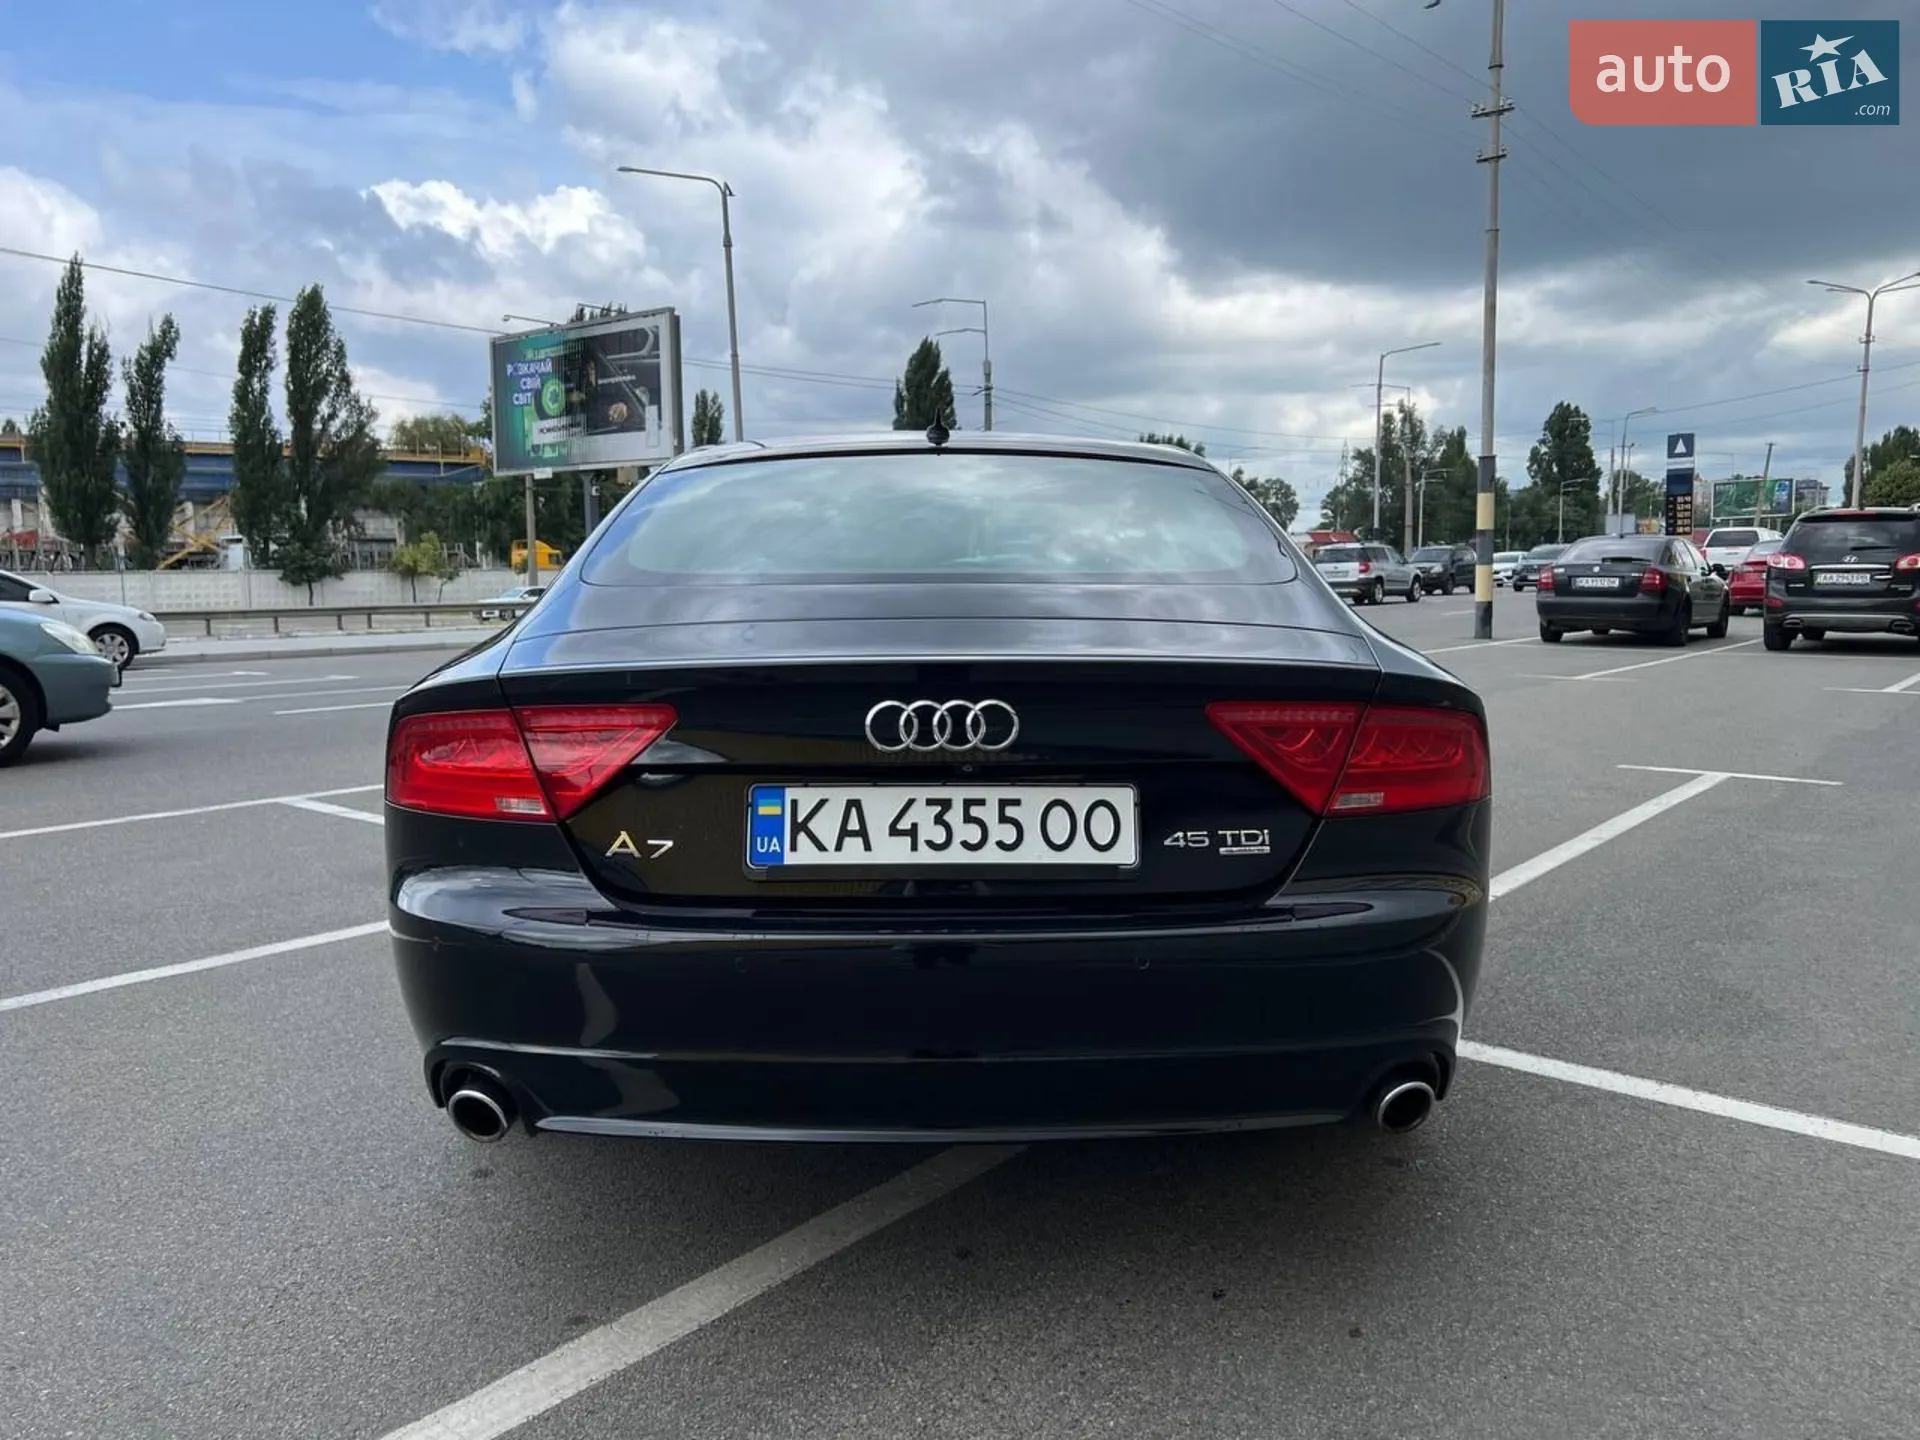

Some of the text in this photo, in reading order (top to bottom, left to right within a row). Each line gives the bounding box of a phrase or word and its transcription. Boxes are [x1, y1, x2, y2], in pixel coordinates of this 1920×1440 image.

[789, 798, 872, 852] KA
[888, 798, 1024, 852] 4355
[757, 836, 781, 853] UA
[1163, 829, 1270, 848] 45 TDI
